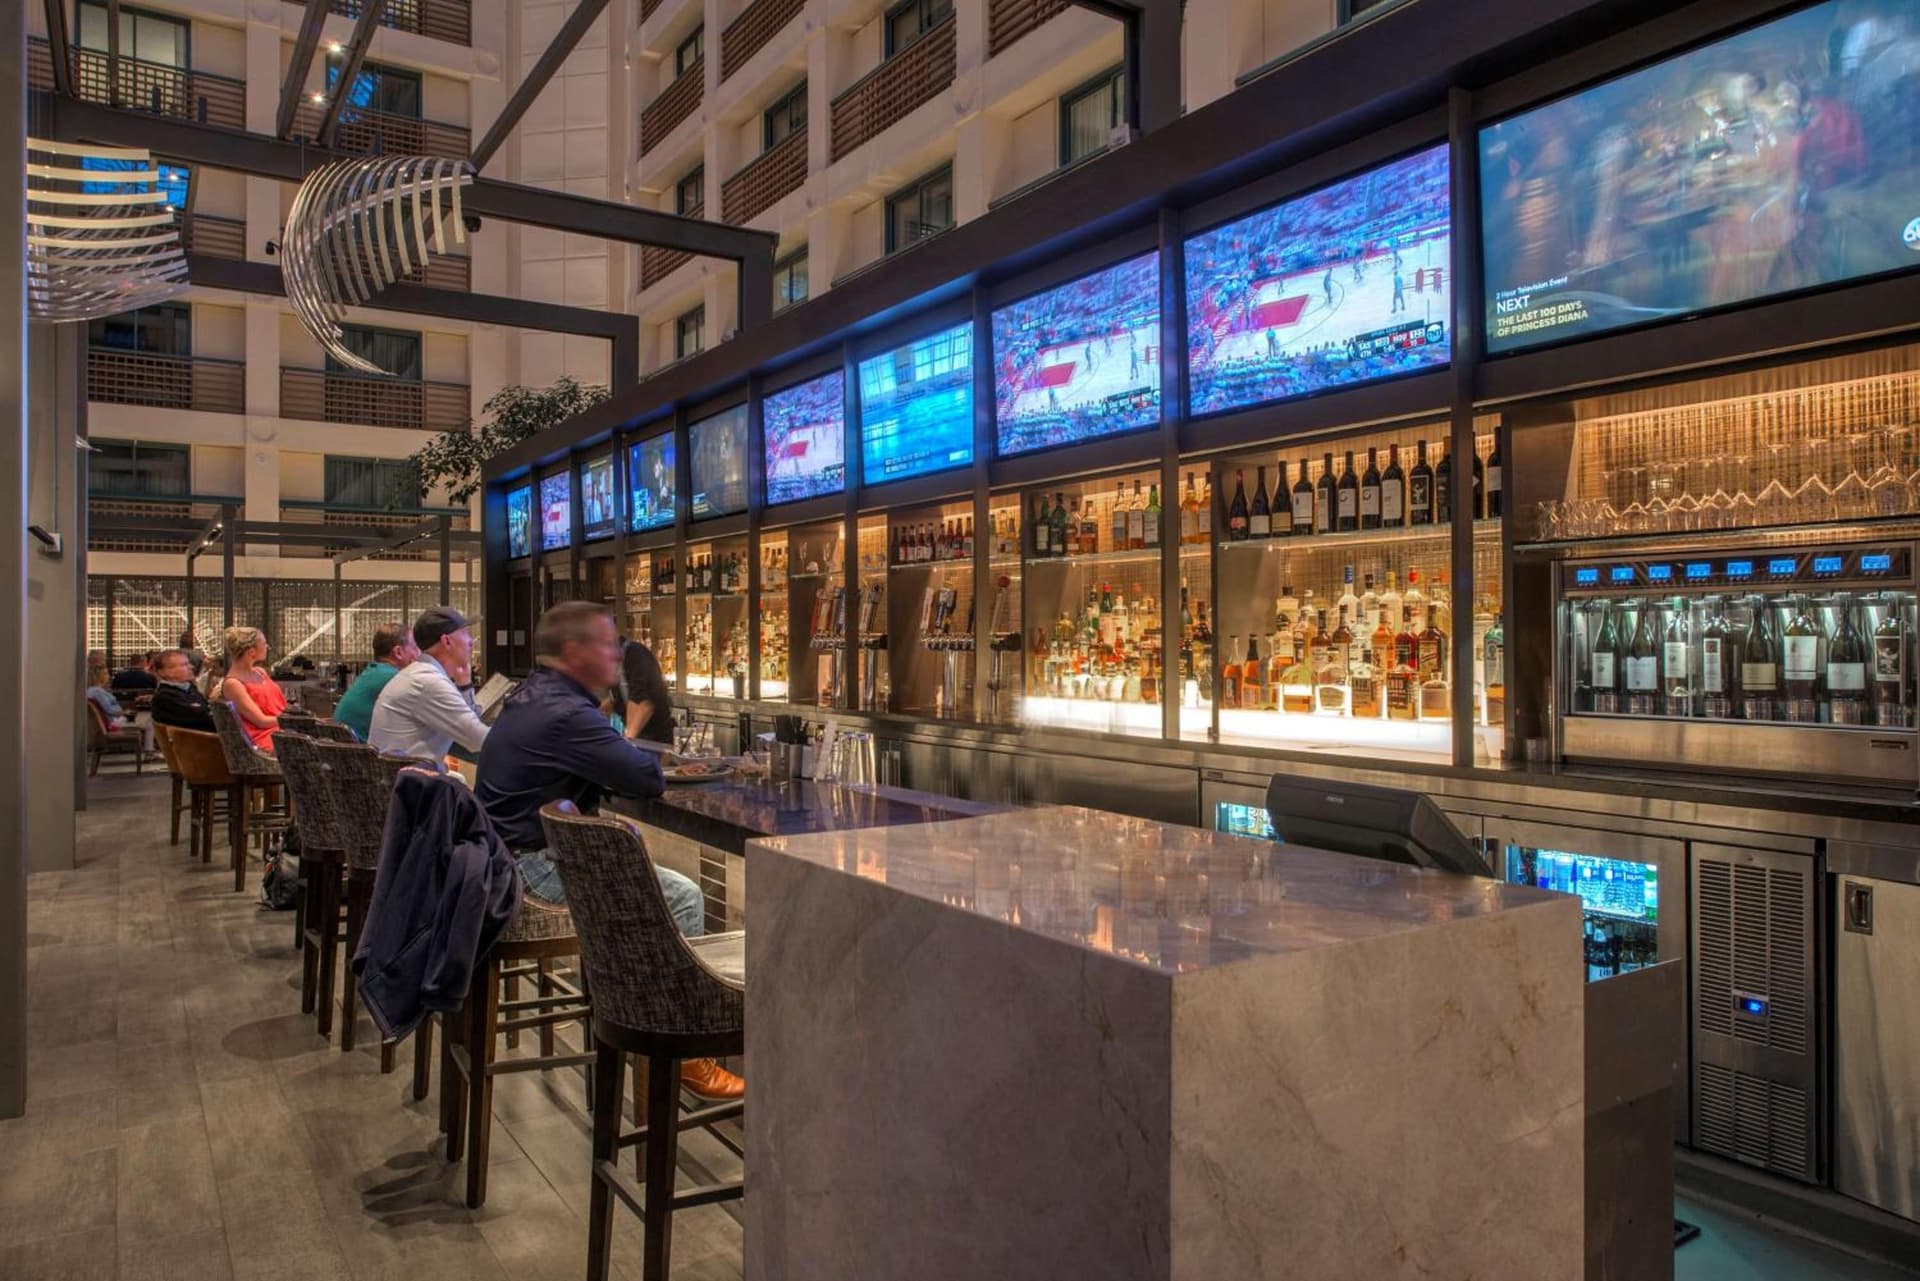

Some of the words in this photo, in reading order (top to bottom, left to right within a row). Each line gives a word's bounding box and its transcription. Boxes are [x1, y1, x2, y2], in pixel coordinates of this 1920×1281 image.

[1517, 282, 1549, 294] Television
[1549, 276, 1568, 286] Event
[1497, 295, 1530, 314] NEXT
[1497, 315, 1516, 328] THE
[1517, 311, 1539, 324] LAST
[1540, 306, 1556, 318] 100
[1558, 301, 1582, 315] DAYS
[1497, 327, 1512, 338] OF
[1512, 317, 1556, 335] PRINCESS
[1558, 310, 1588, 325] DIANA
